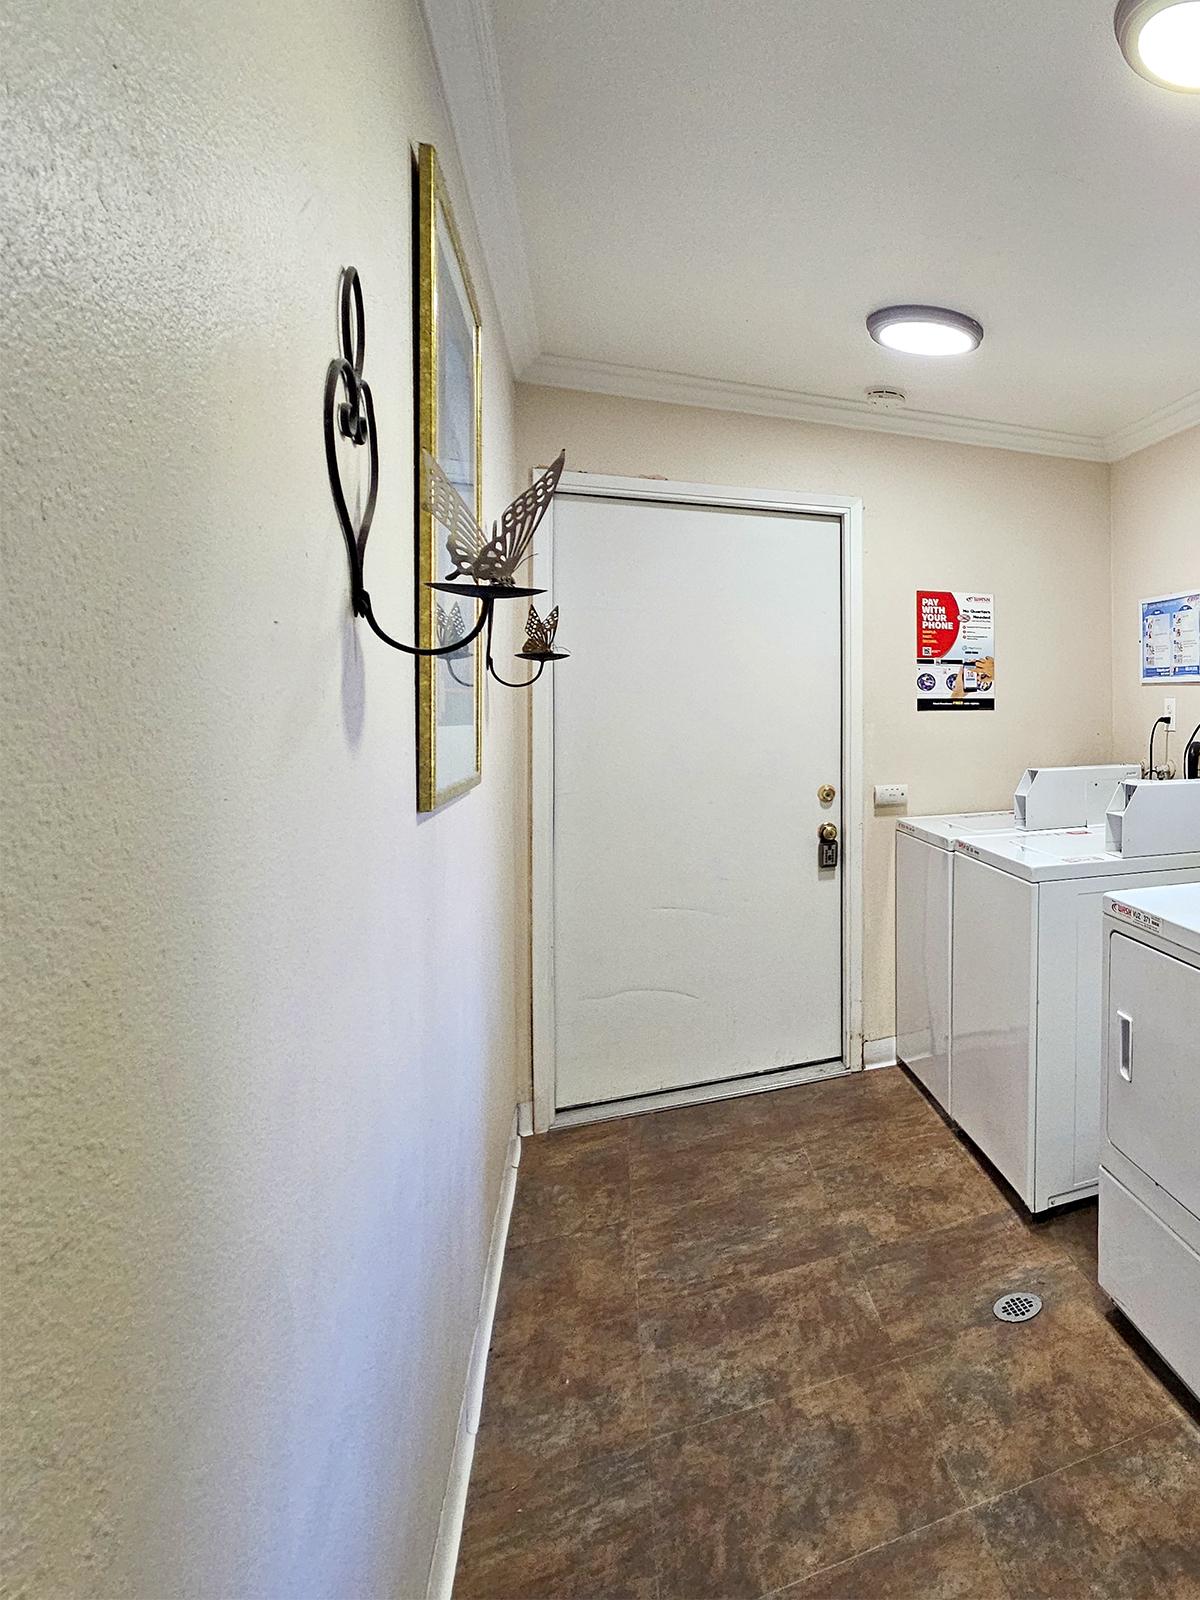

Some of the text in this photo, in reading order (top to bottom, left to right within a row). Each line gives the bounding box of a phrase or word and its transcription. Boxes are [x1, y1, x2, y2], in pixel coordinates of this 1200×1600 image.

[922, 598, 939, 606] PAY
[922, 606, 946, 614] WITH
[922, 622, 954, 630] PHONE
